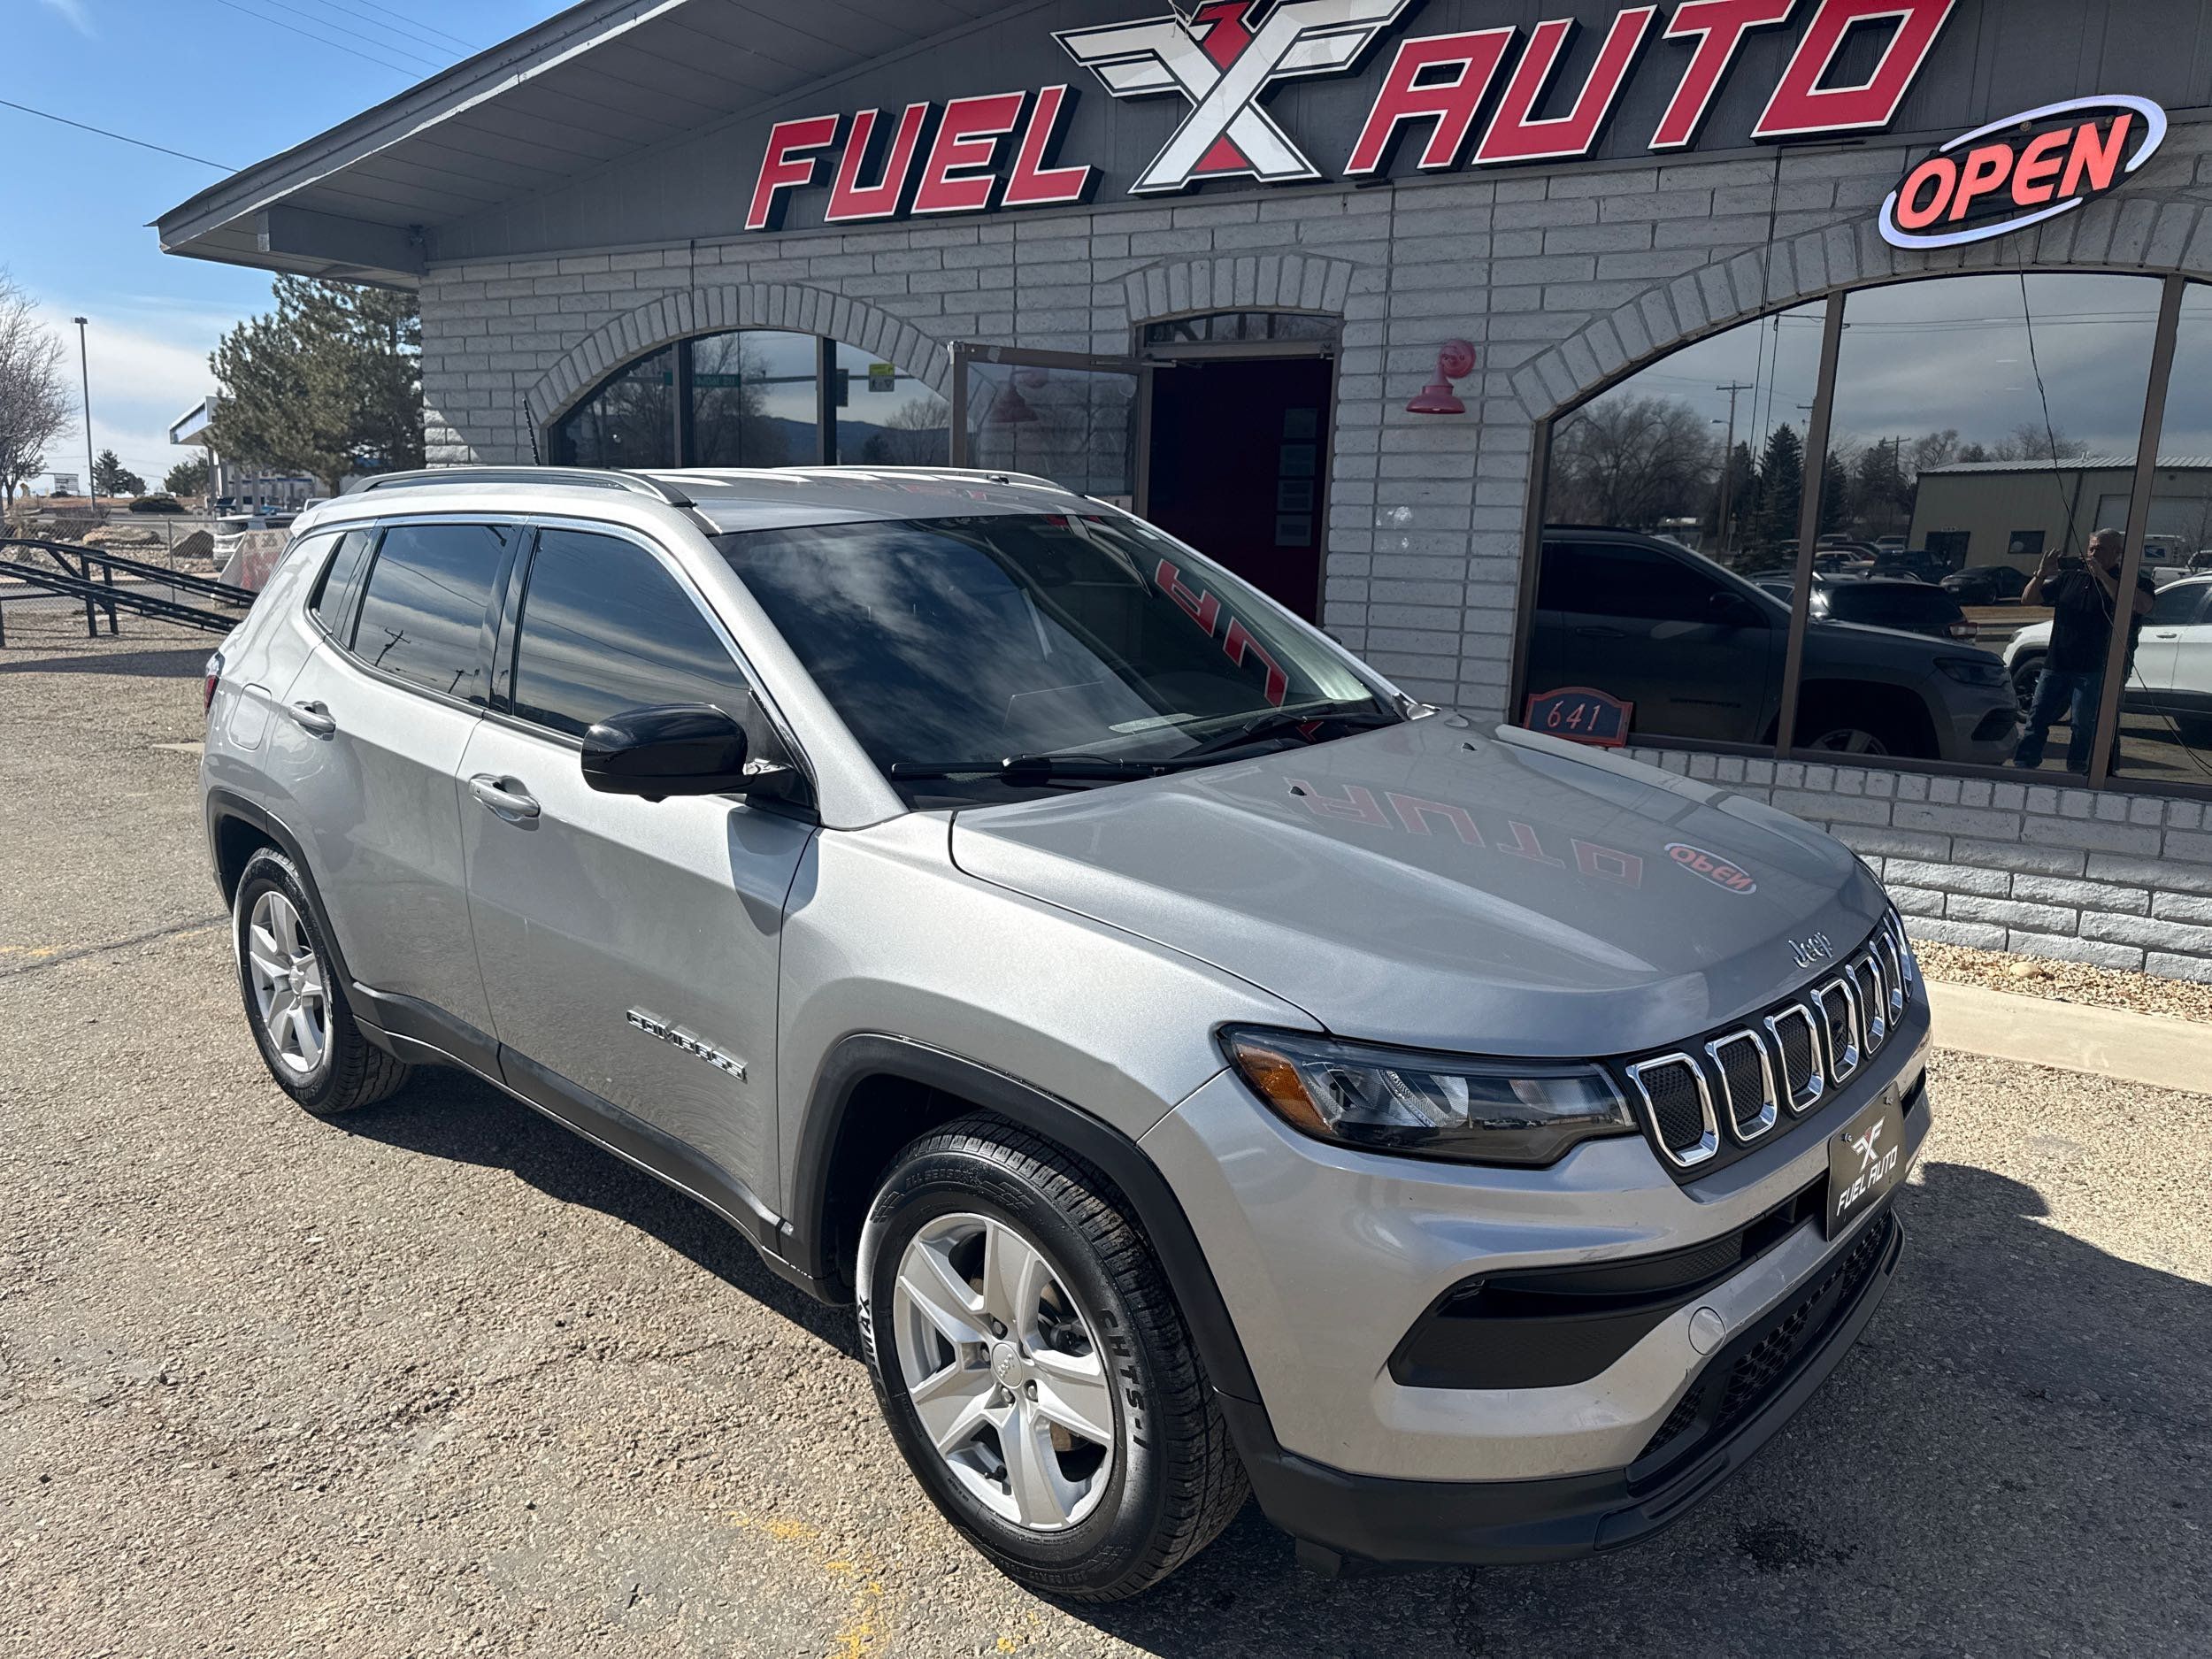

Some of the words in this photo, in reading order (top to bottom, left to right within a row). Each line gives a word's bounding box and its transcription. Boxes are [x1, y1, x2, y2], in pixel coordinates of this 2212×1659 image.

[744, 83, 1091, 230] FUEL
[1342, 0, 1954, 177] AUTO
[1897, 113, 2133, 229] OPEN
[1548, 700, 1601, 731] 641
[1788, 932, 1833, 969] Jeep
[1836, 1174, 1866, 1217] FUEL
[1867, 1145, 1899, 1189] AUTO
